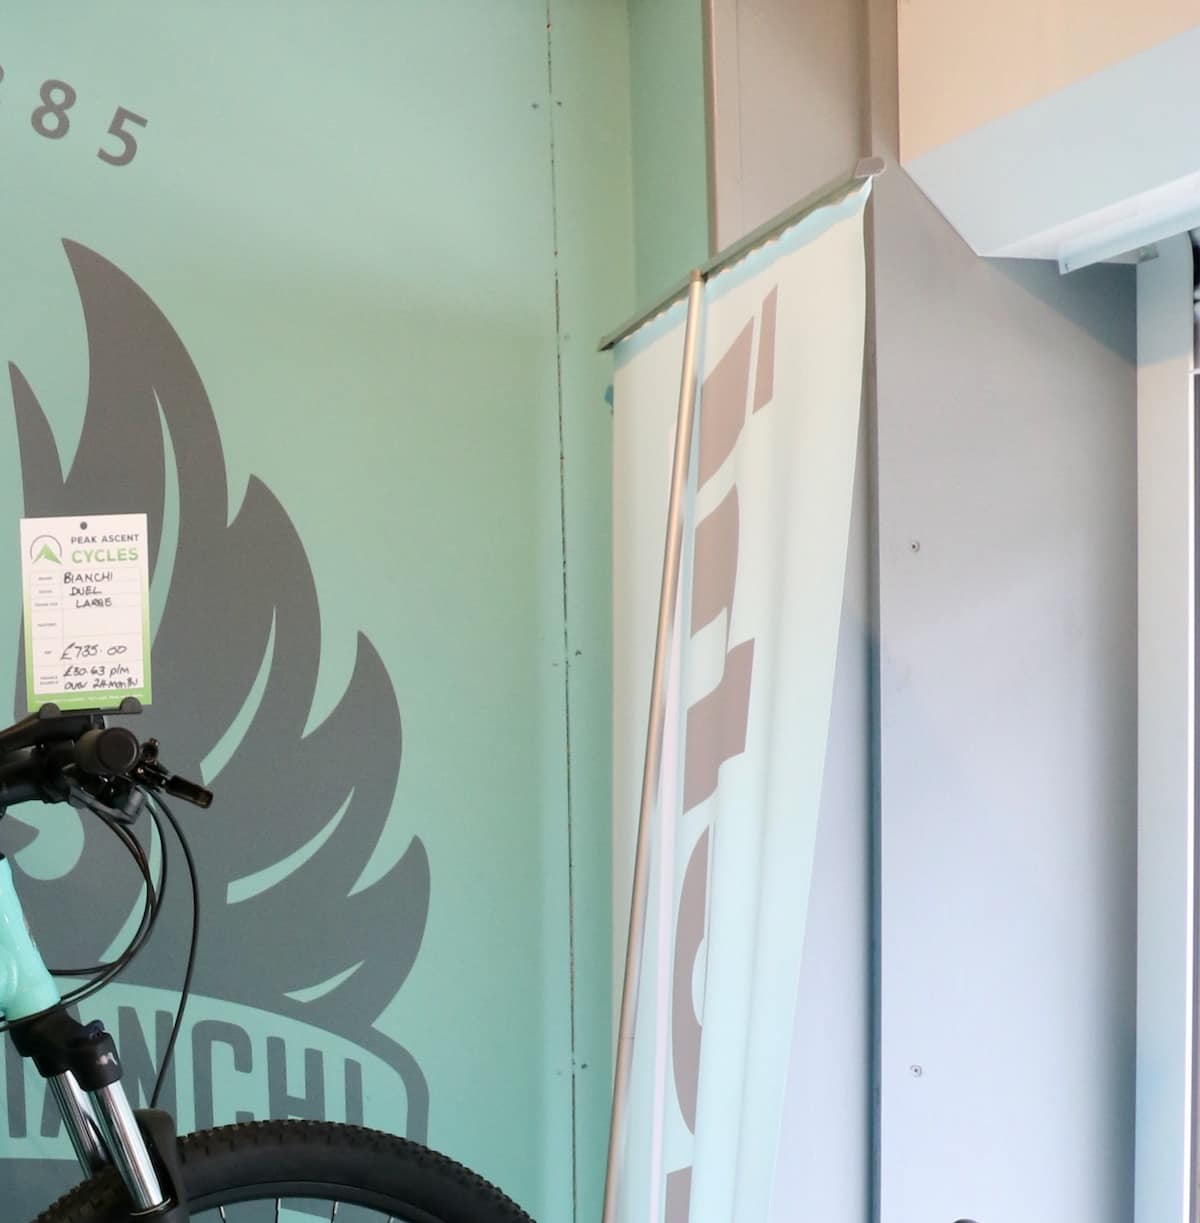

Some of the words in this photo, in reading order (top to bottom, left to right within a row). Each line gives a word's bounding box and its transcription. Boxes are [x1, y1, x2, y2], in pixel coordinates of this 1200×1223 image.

[71, 535, 97, 544] PEAK
[101, 534, 139, 543] ASCENT
[71, 547, 139, 564] CYCLES
[63, 571, 113, 584] BIANCHI
[69, 586, 103, 597] DUEL
